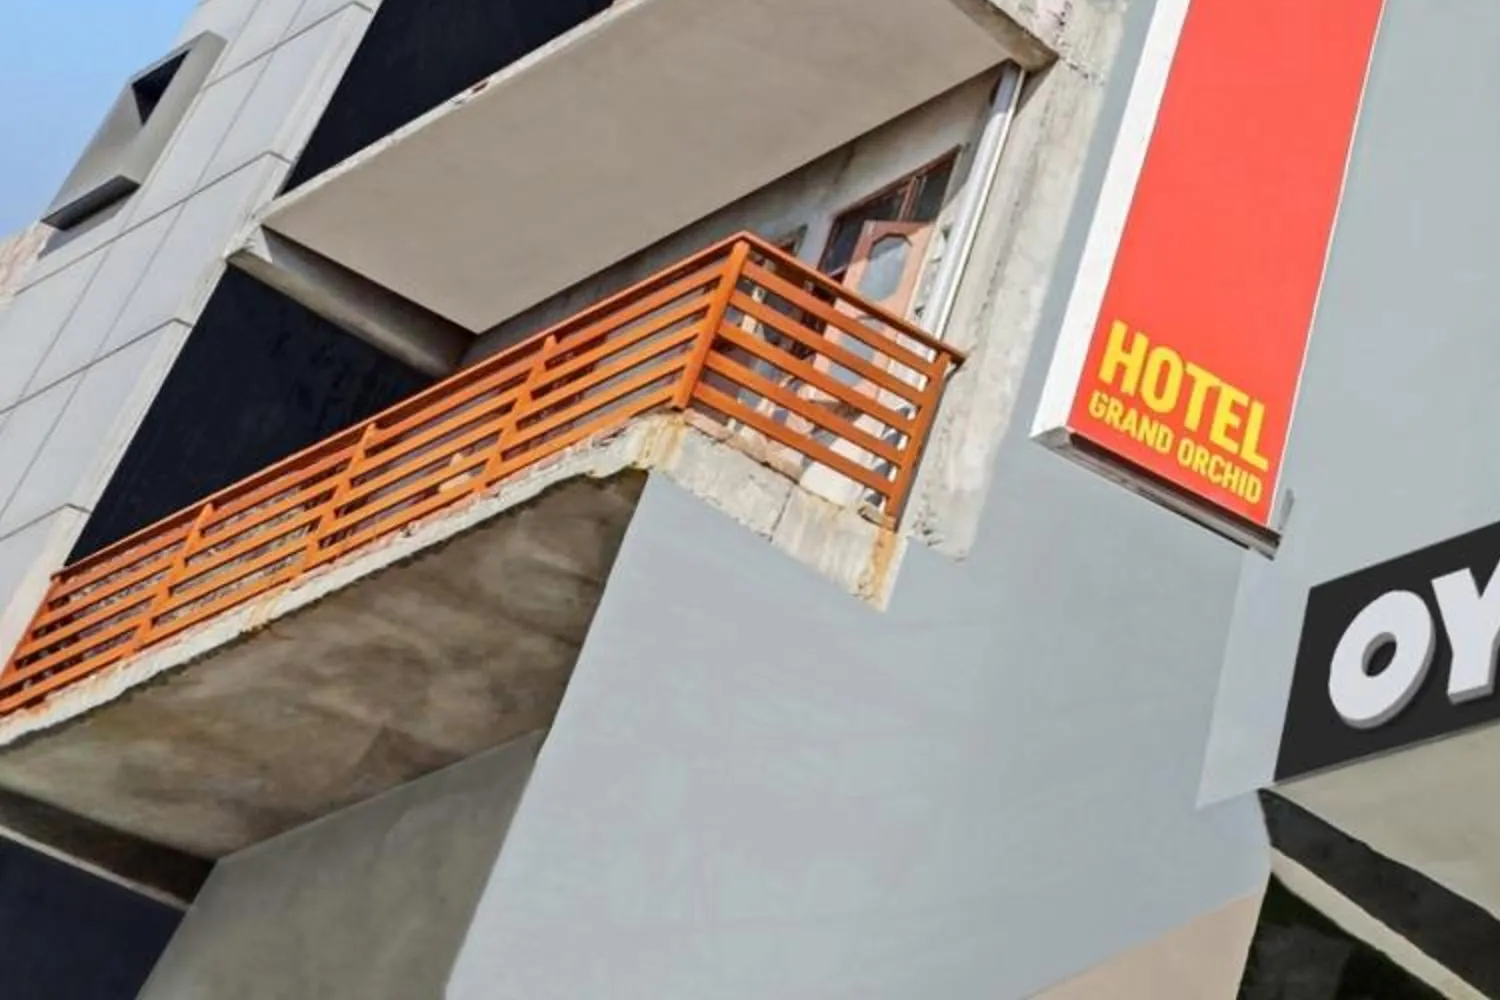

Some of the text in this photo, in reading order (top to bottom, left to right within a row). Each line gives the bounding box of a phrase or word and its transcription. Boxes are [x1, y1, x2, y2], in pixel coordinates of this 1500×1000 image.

[1088, 391, 1262, 504] GRAND ORCHID
[1099, 320, 1269, 472] HOTEL
